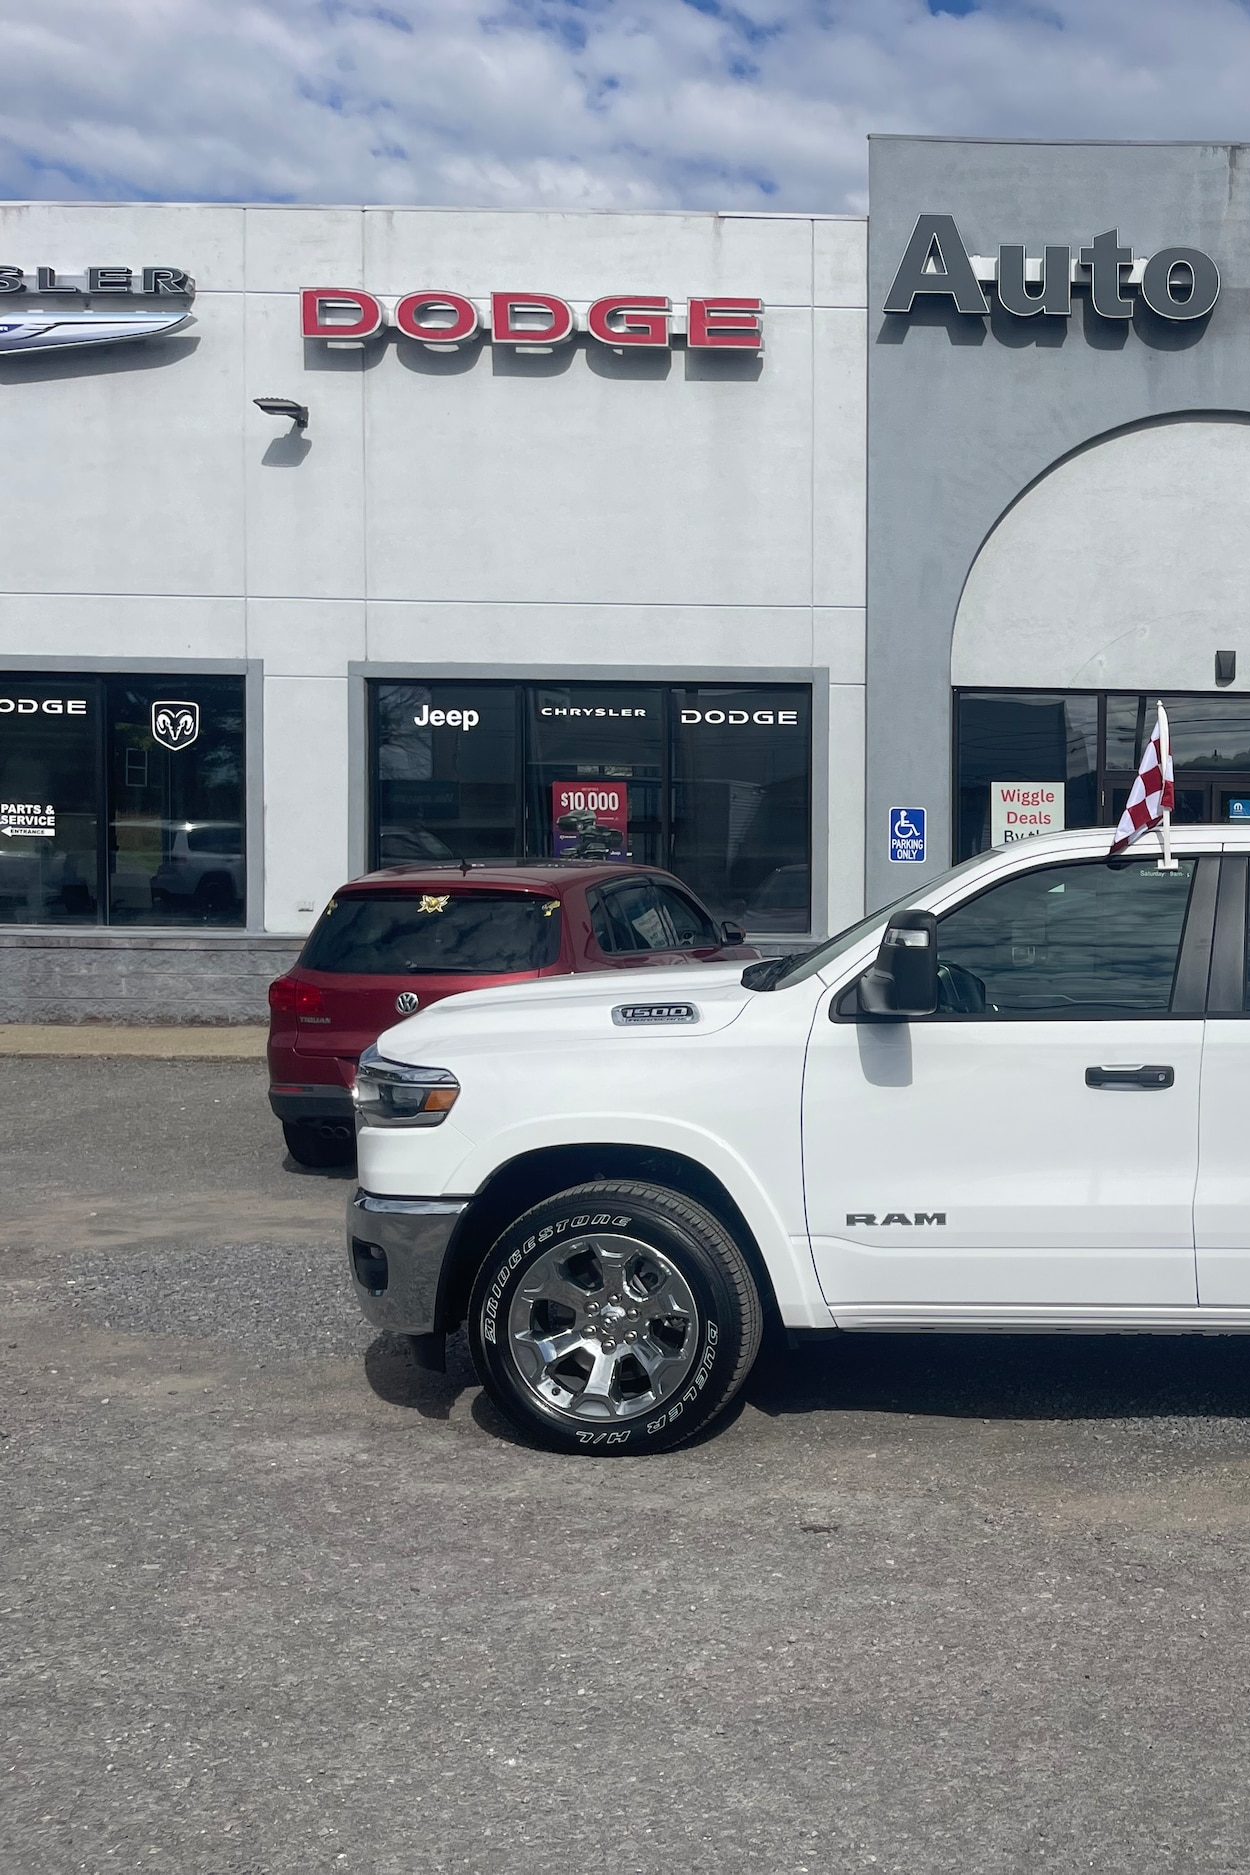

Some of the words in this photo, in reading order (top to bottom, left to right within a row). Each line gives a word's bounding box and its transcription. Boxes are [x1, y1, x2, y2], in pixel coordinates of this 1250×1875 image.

[881, 211, 1221, 321] Auto
[299, 286, 764, 350] DODGE
[413, 704, 480, 731] Jeep
[541, 707, 647, 717] CHRYSLER
[681, 709, 798, 725] DODGE
[560, 791, 619, 811] $10,000
[1000, 788, 1055, 806] Wiggle
[0, 804, 42, 815] PARTS
[45, 805, 55, 815] &
[0, 815, 56, 826] SERVICE
[1006, 811, 1052, 825] Deals
[891, 838, 924, 849] PARKING
[896, 849, 919, 860] ONLY
[623, 1007, 688, 1018] 1500
[845, 1212, 947, 1226] RAM
[484, 1213, 633, 1345] BRIDGESTONE
[647, 1320, 719, 1435] DUELER
